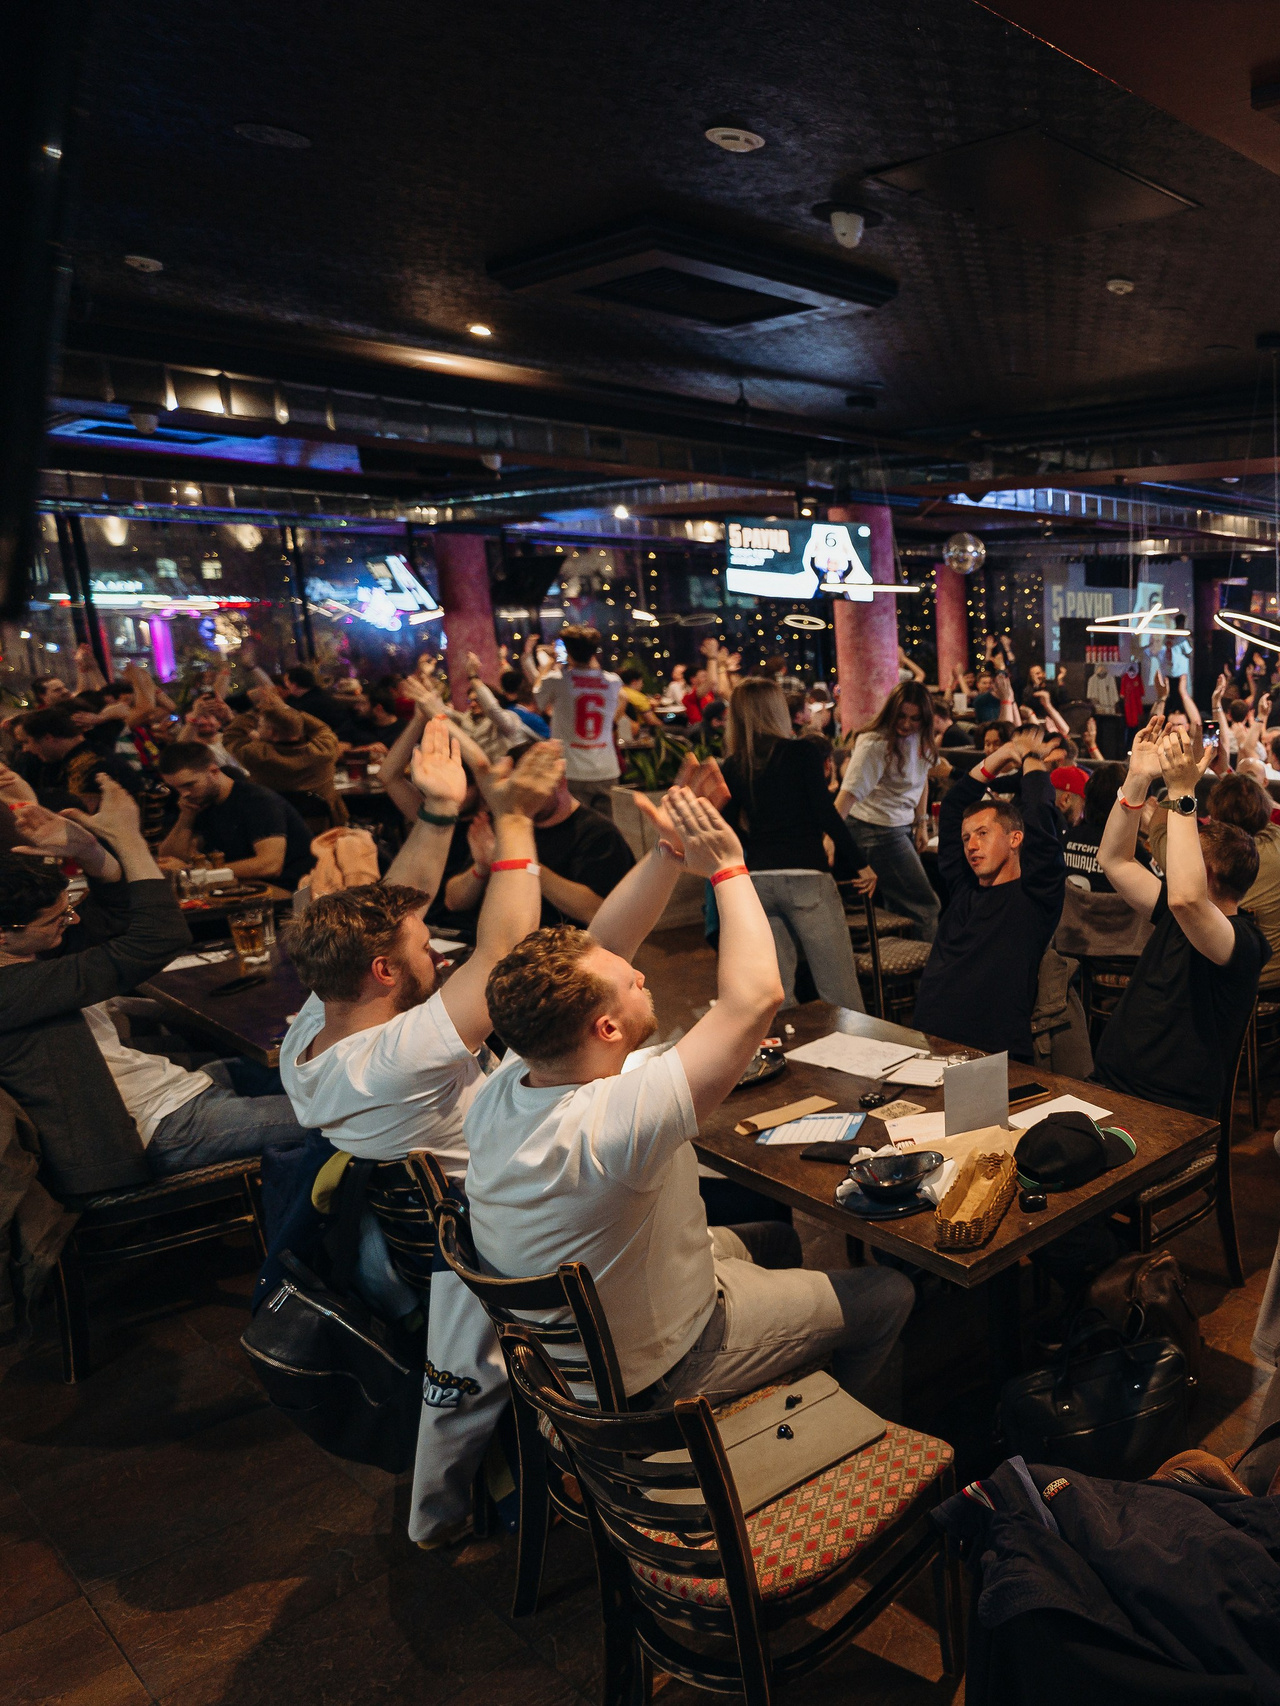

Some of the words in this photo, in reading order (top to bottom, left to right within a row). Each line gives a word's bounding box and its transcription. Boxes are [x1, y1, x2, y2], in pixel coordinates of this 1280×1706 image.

[825, 532, 837, 547] 6
[1051, 585, 1064, 622] 5
[576, 692, 606, 740] 6
[1066, 841, 1099, 854] БЕТСИТ
